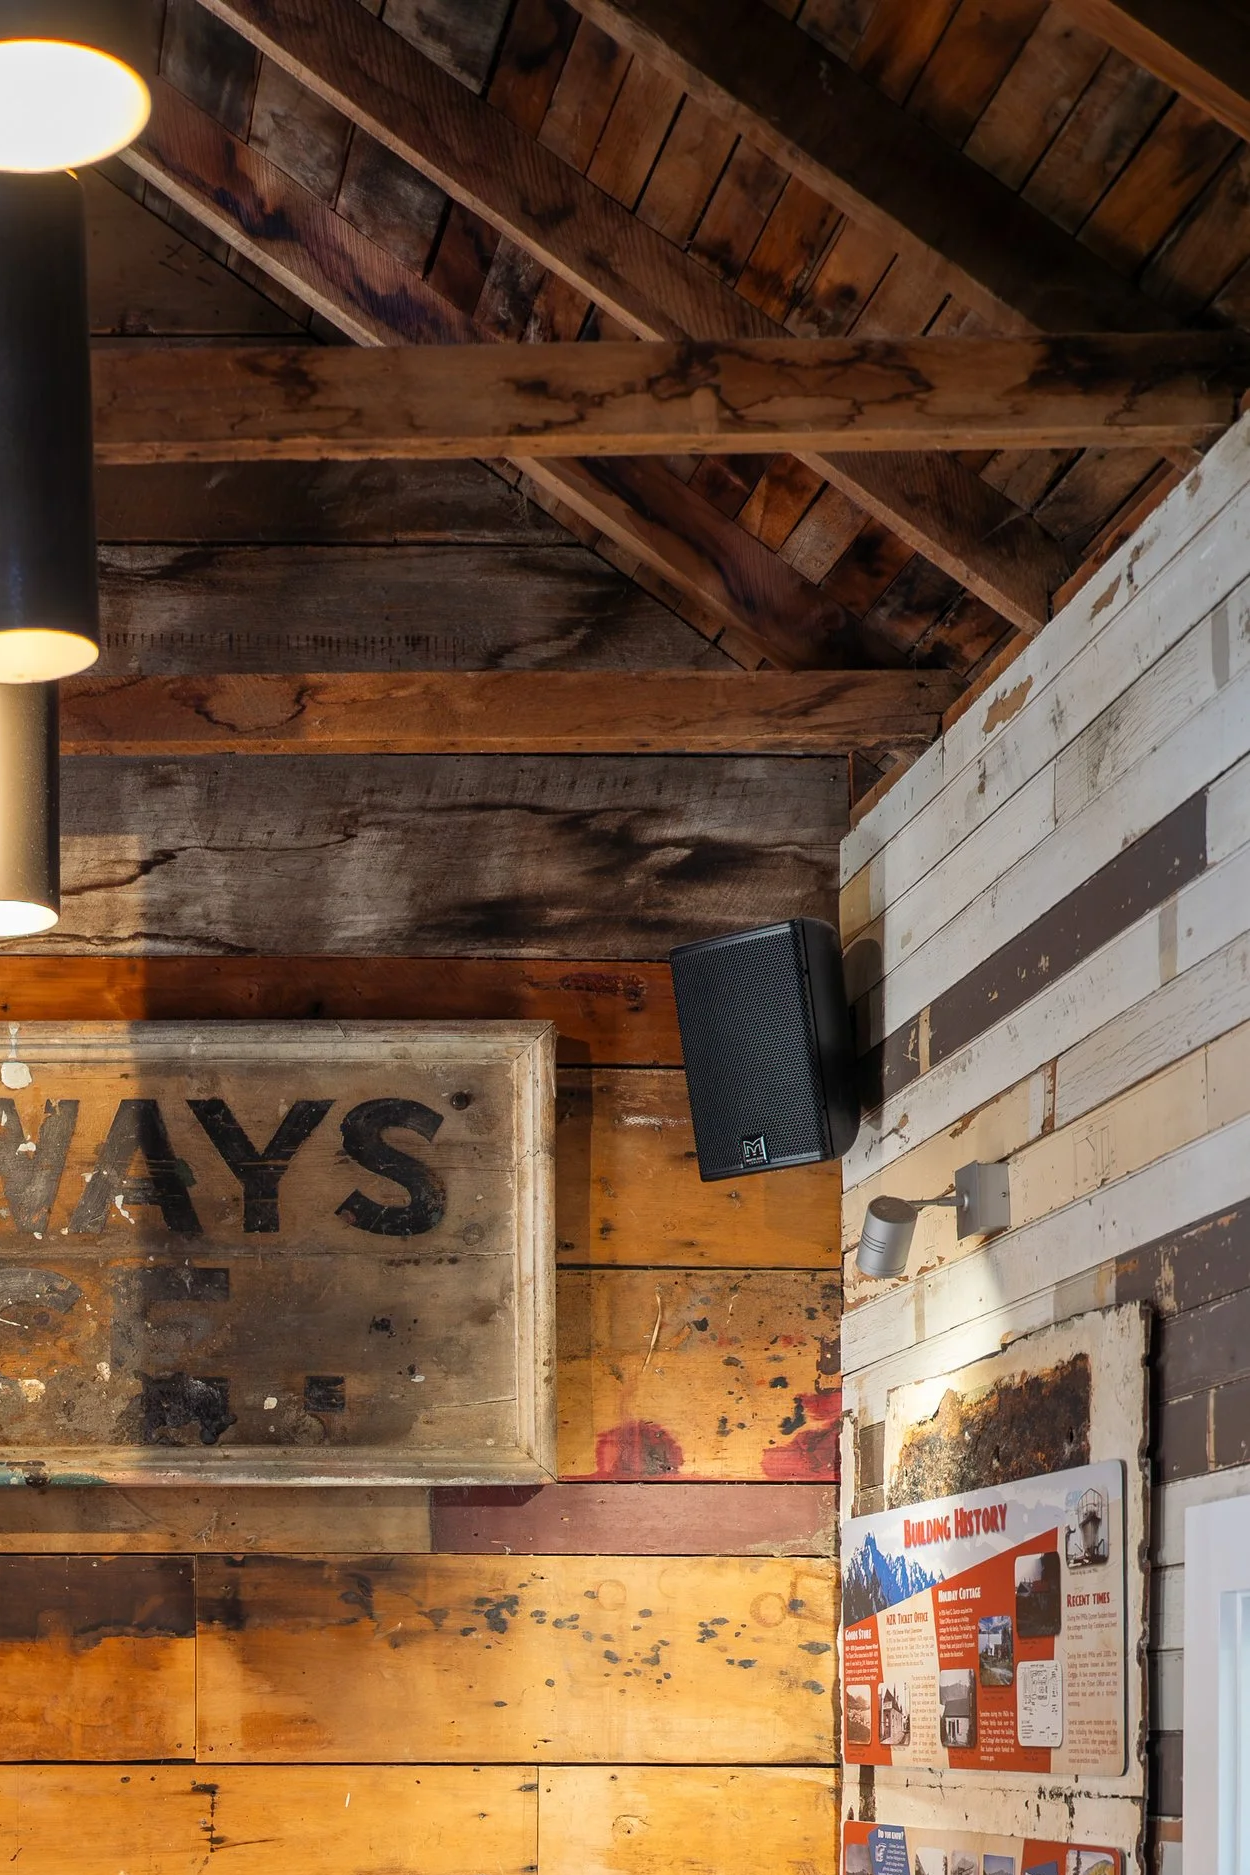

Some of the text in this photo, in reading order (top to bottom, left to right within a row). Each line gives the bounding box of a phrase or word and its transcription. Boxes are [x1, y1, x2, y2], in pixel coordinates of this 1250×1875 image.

[904, 1503, 1007, 1548] BUILDING HISTORY
[938, 1586, 981, 1603] HOLIDAY COTTAGE
[1067, 1592, 1110, 1607] RECENT TIMES
[898, 1613, 913, 1624] TICKET
[913, 1612, 928, 1623] OFFICE
